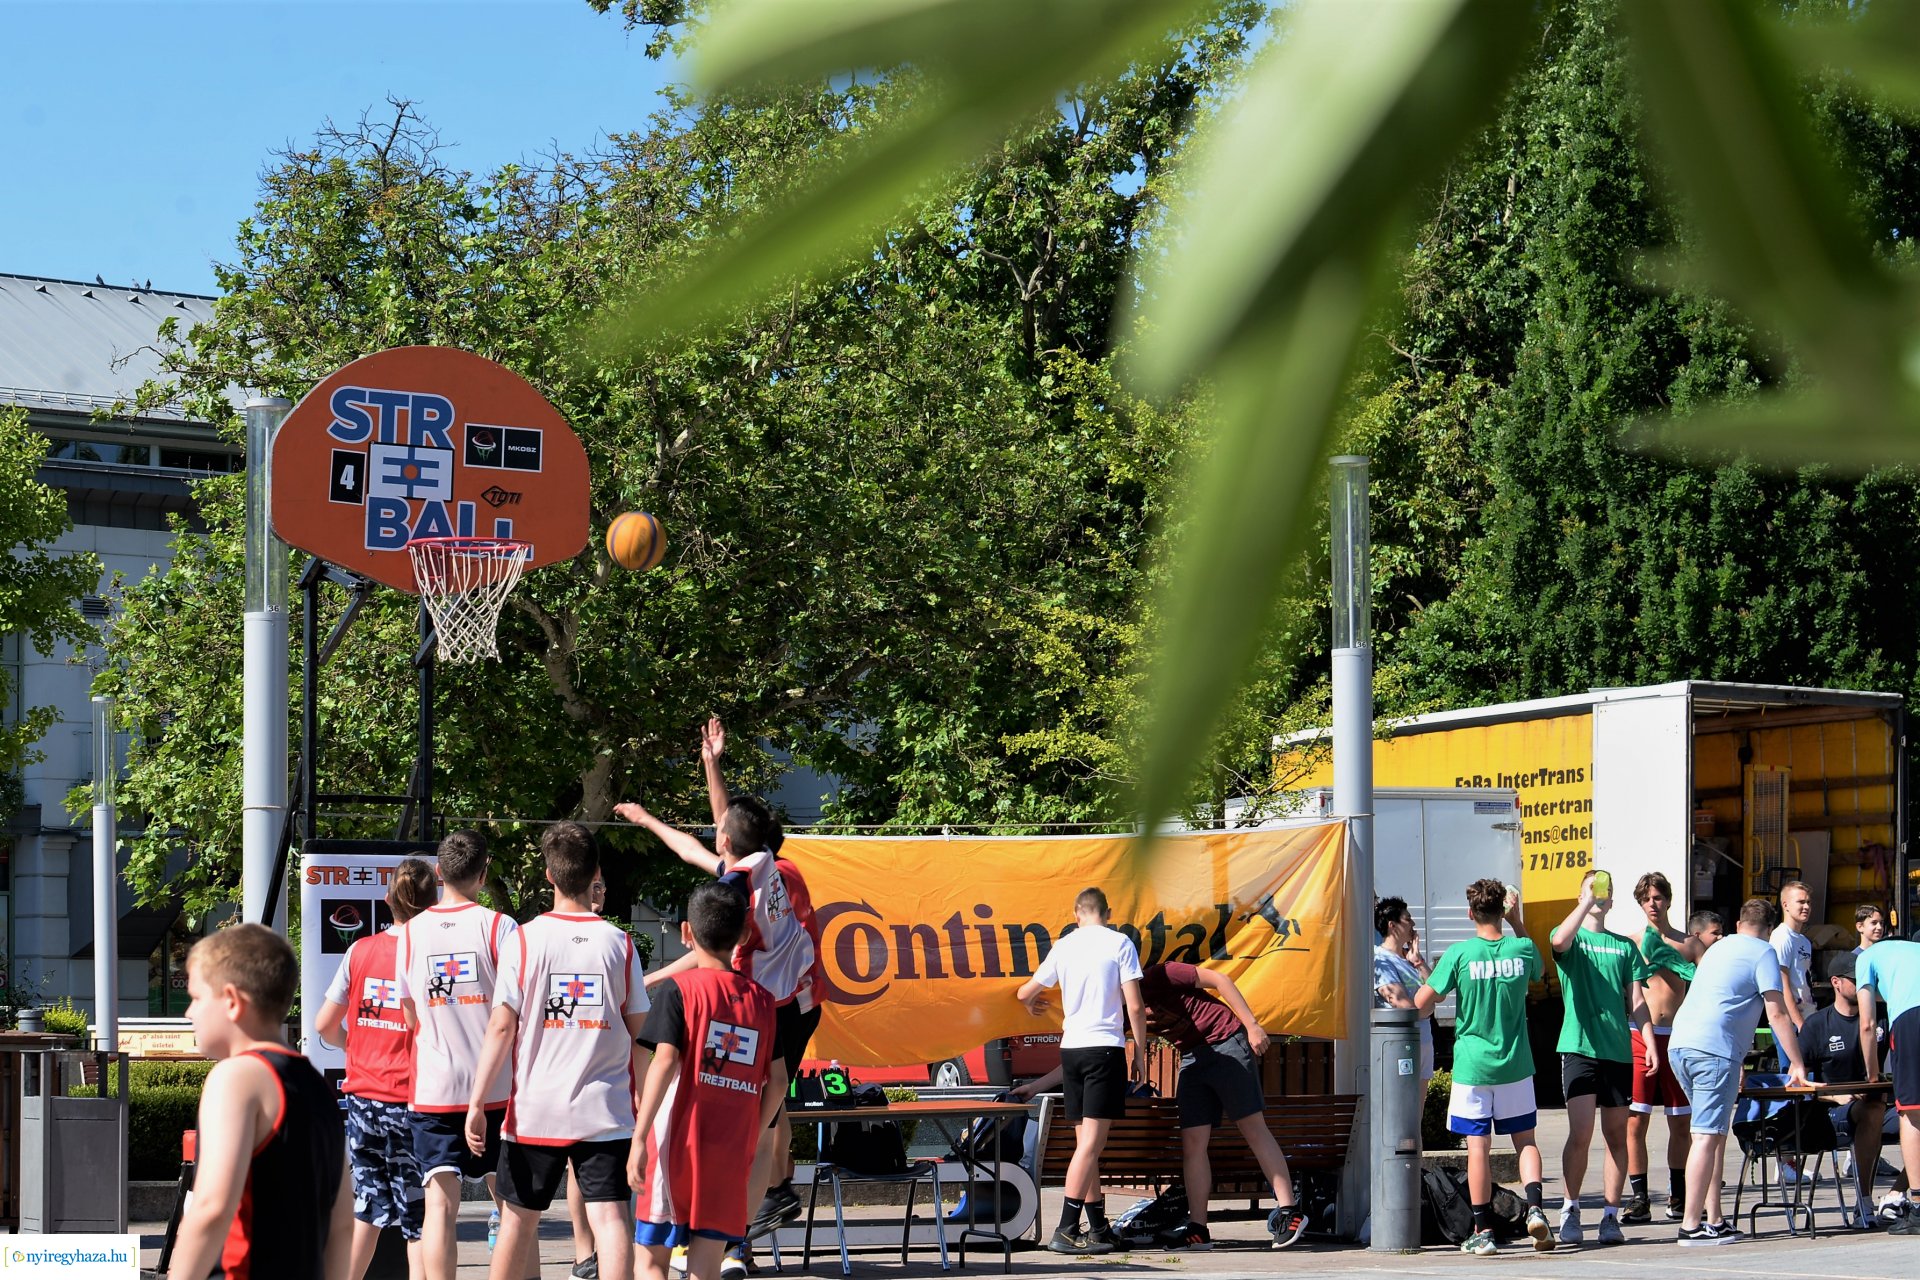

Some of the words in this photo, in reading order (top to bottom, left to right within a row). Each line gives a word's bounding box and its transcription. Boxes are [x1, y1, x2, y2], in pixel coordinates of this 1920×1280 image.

[327, 385, 456, 449] STR
[508, 445, 537, 453] MKOSZ
[339, 464, 355, 490] 4
[364, 494, 535, 562] BALL
[1497, 768, 1585, 789] InterTrans
[1468, 957, 1525, 980] MAJOR
[1023, 1035, 1060, 1044] CITROËN
[824, 1072, 848, 1095] 3
